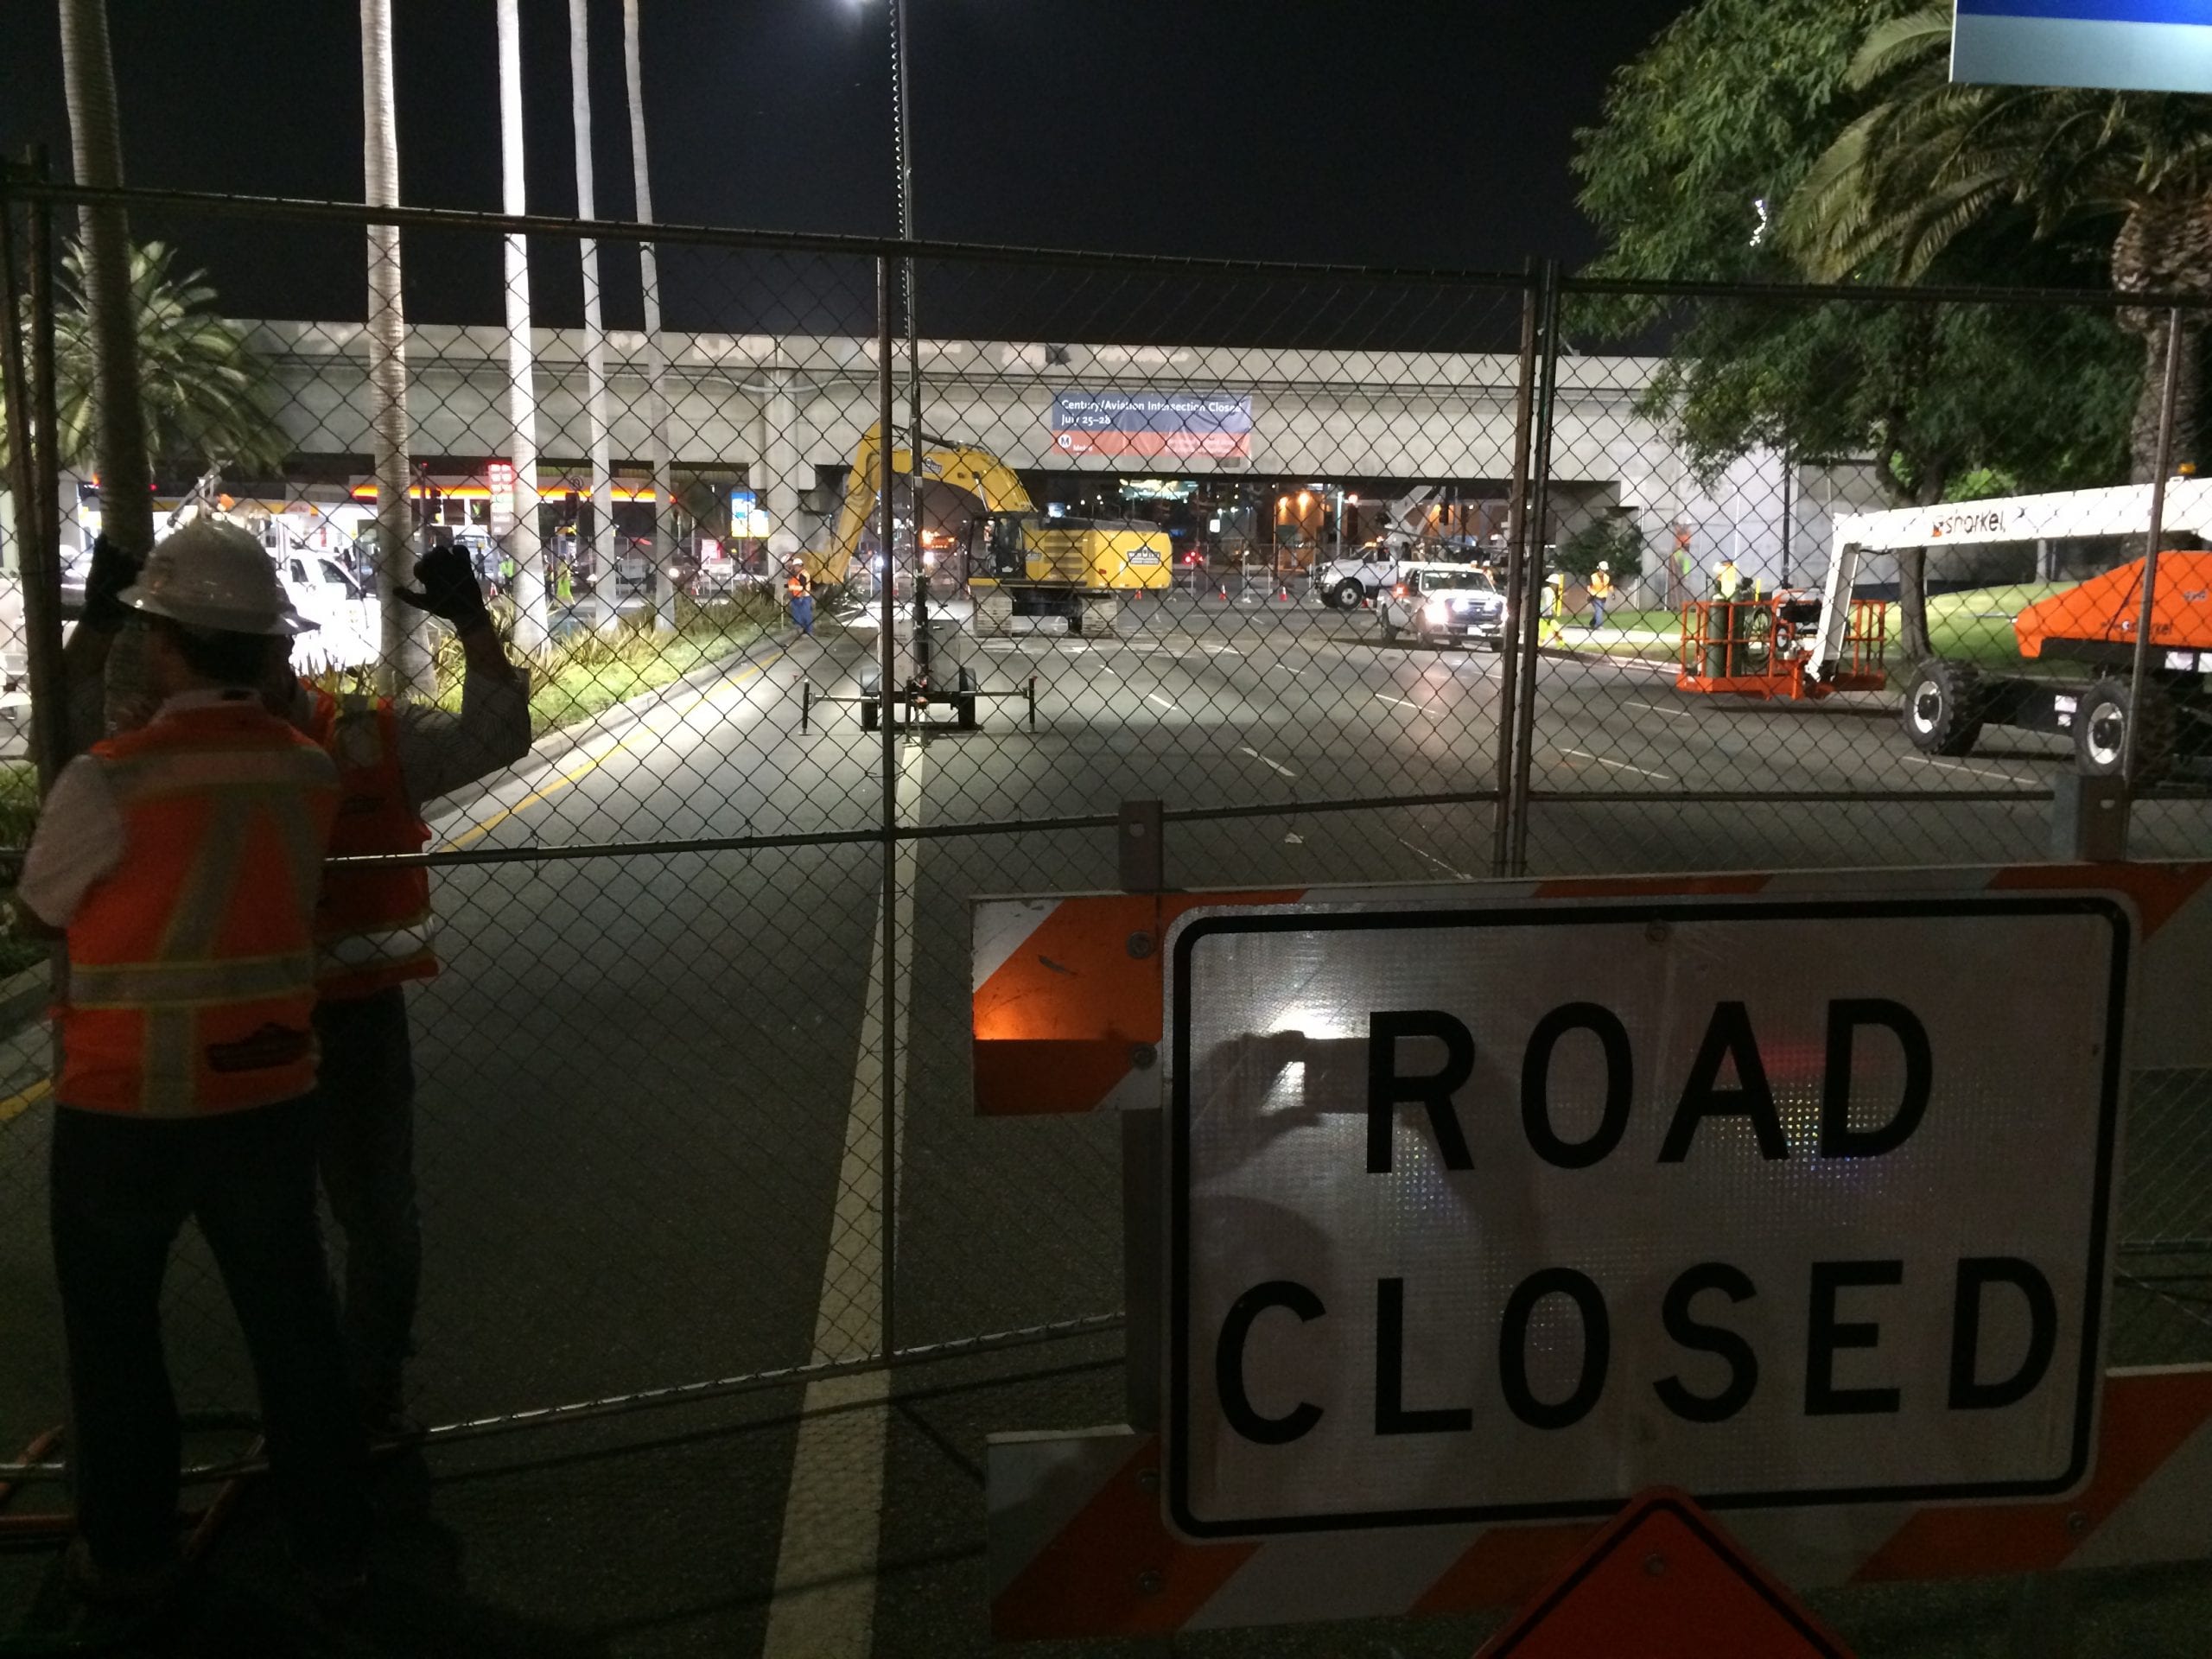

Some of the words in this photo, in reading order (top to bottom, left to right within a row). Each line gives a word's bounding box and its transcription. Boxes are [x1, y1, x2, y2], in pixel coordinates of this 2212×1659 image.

[1061, 399, 1145, 412] Century/Aviation
[1147, 400, 1206, 412] Intersection
[1209, 402, 1243, 412] Closed
[1061, 414, 1079, 427] July
[1366, 998, 1933, 1173] ROAD
[1216, 1256, 2058, 1445] CLOSED
